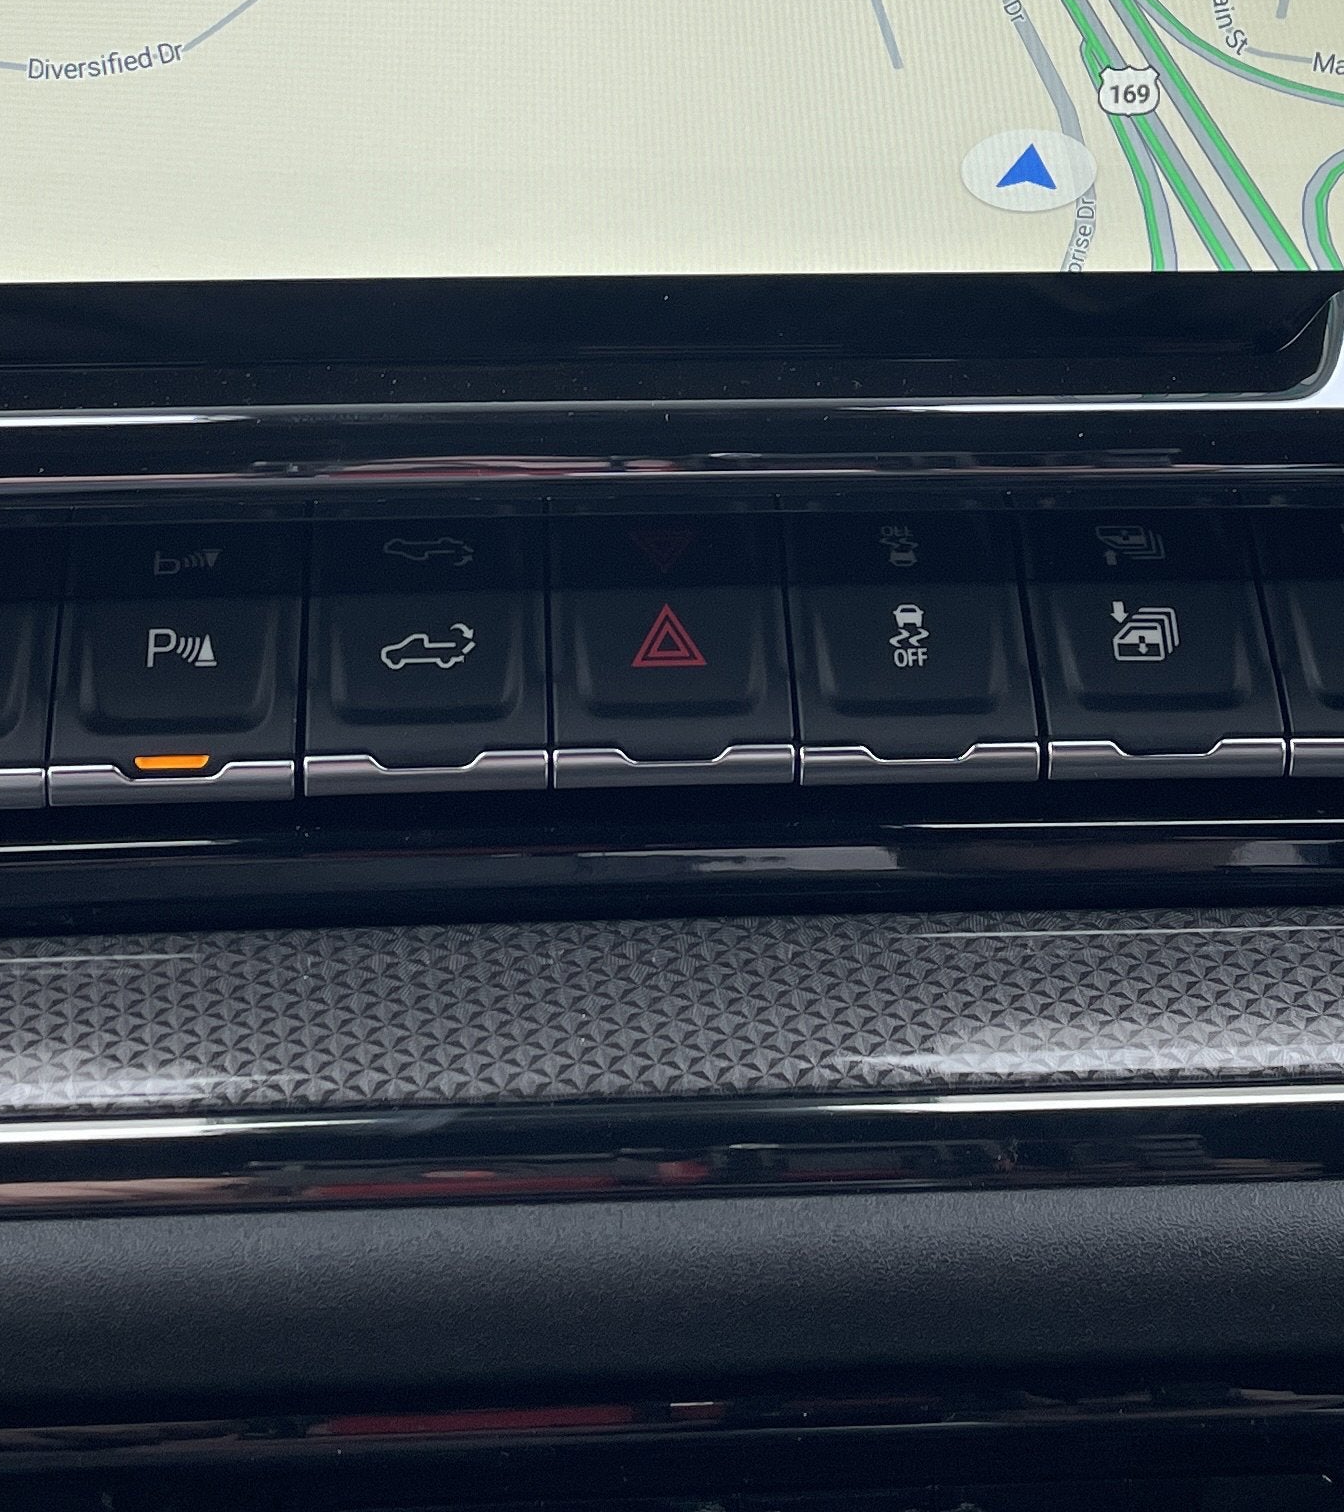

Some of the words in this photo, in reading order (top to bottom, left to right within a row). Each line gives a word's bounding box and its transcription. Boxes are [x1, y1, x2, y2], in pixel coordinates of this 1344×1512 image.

[1225, 29, 1249, 56] St
[27, 47, 153, 80] Diversified
[158, 43, 183, 64] Dr
[1109, 85, 1151, 104] 169
[1077, 198, 1095, 219] Dr
[894, 646, 927, 669] OFF
